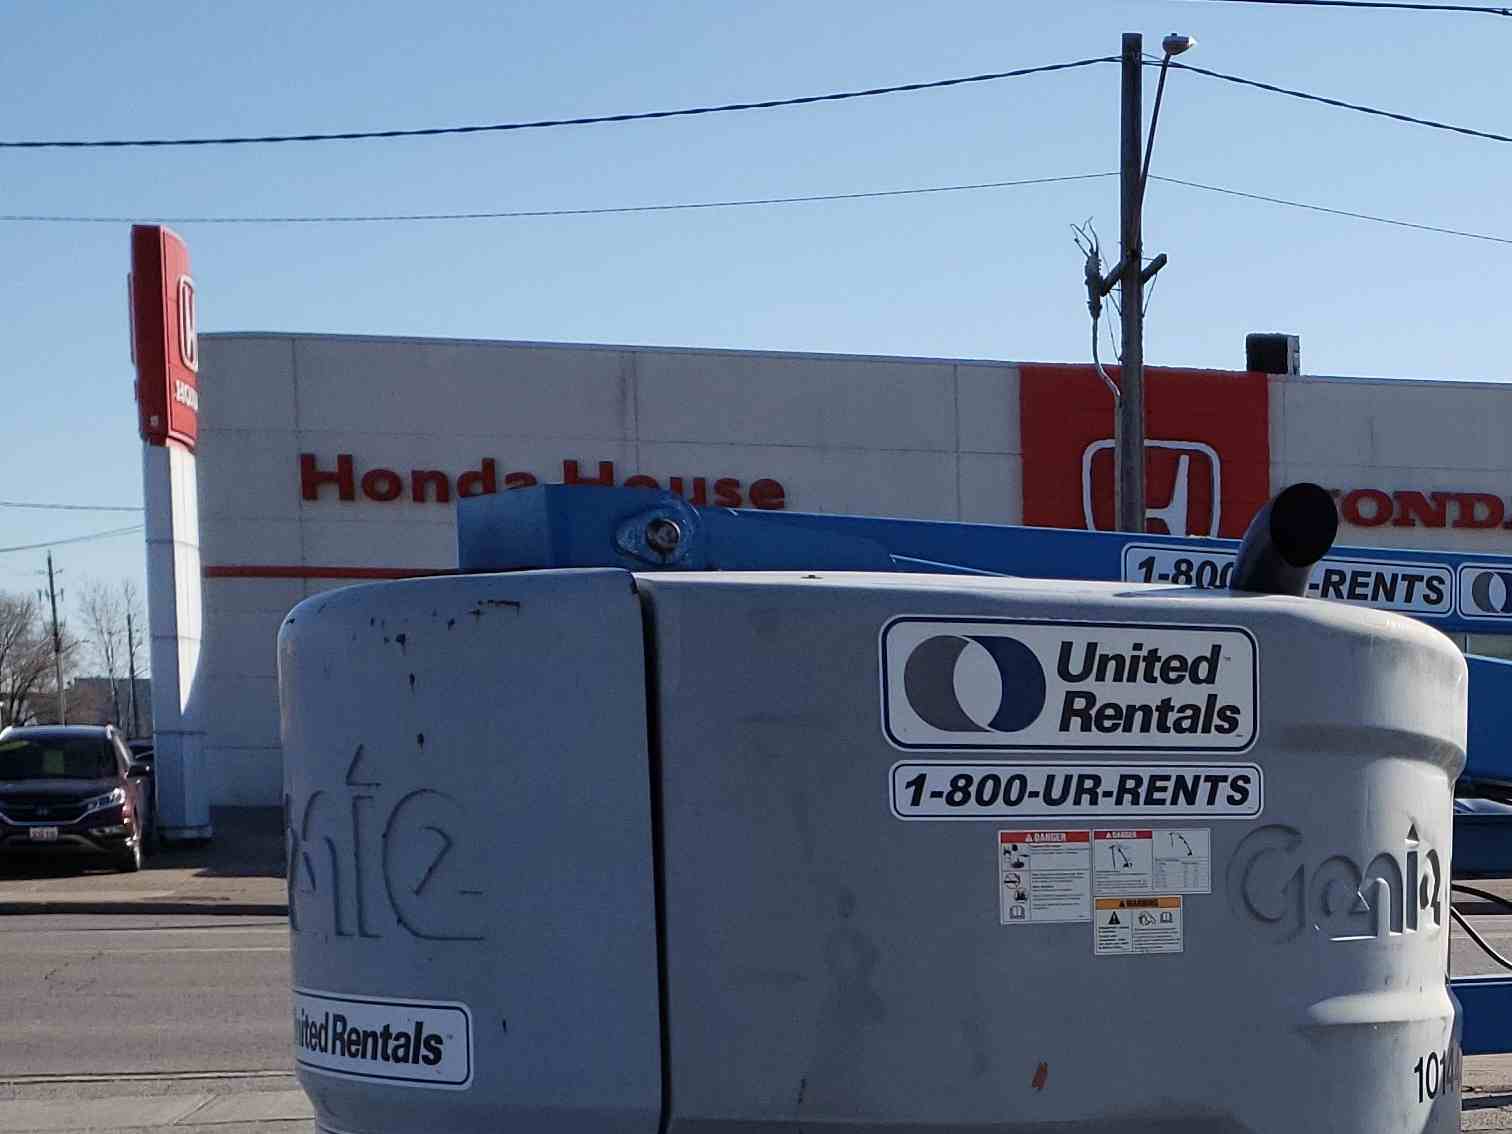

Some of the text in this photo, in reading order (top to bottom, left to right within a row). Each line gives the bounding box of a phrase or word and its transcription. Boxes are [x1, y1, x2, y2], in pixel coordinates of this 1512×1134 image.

[1057, 640, 1222, 685] United
[1058, 690, 1241, 734] Rentals
[904, 773, 1252, 808] 1-800-UR-RENTS
[296, 1008, 444, 1066] ited Rentals
